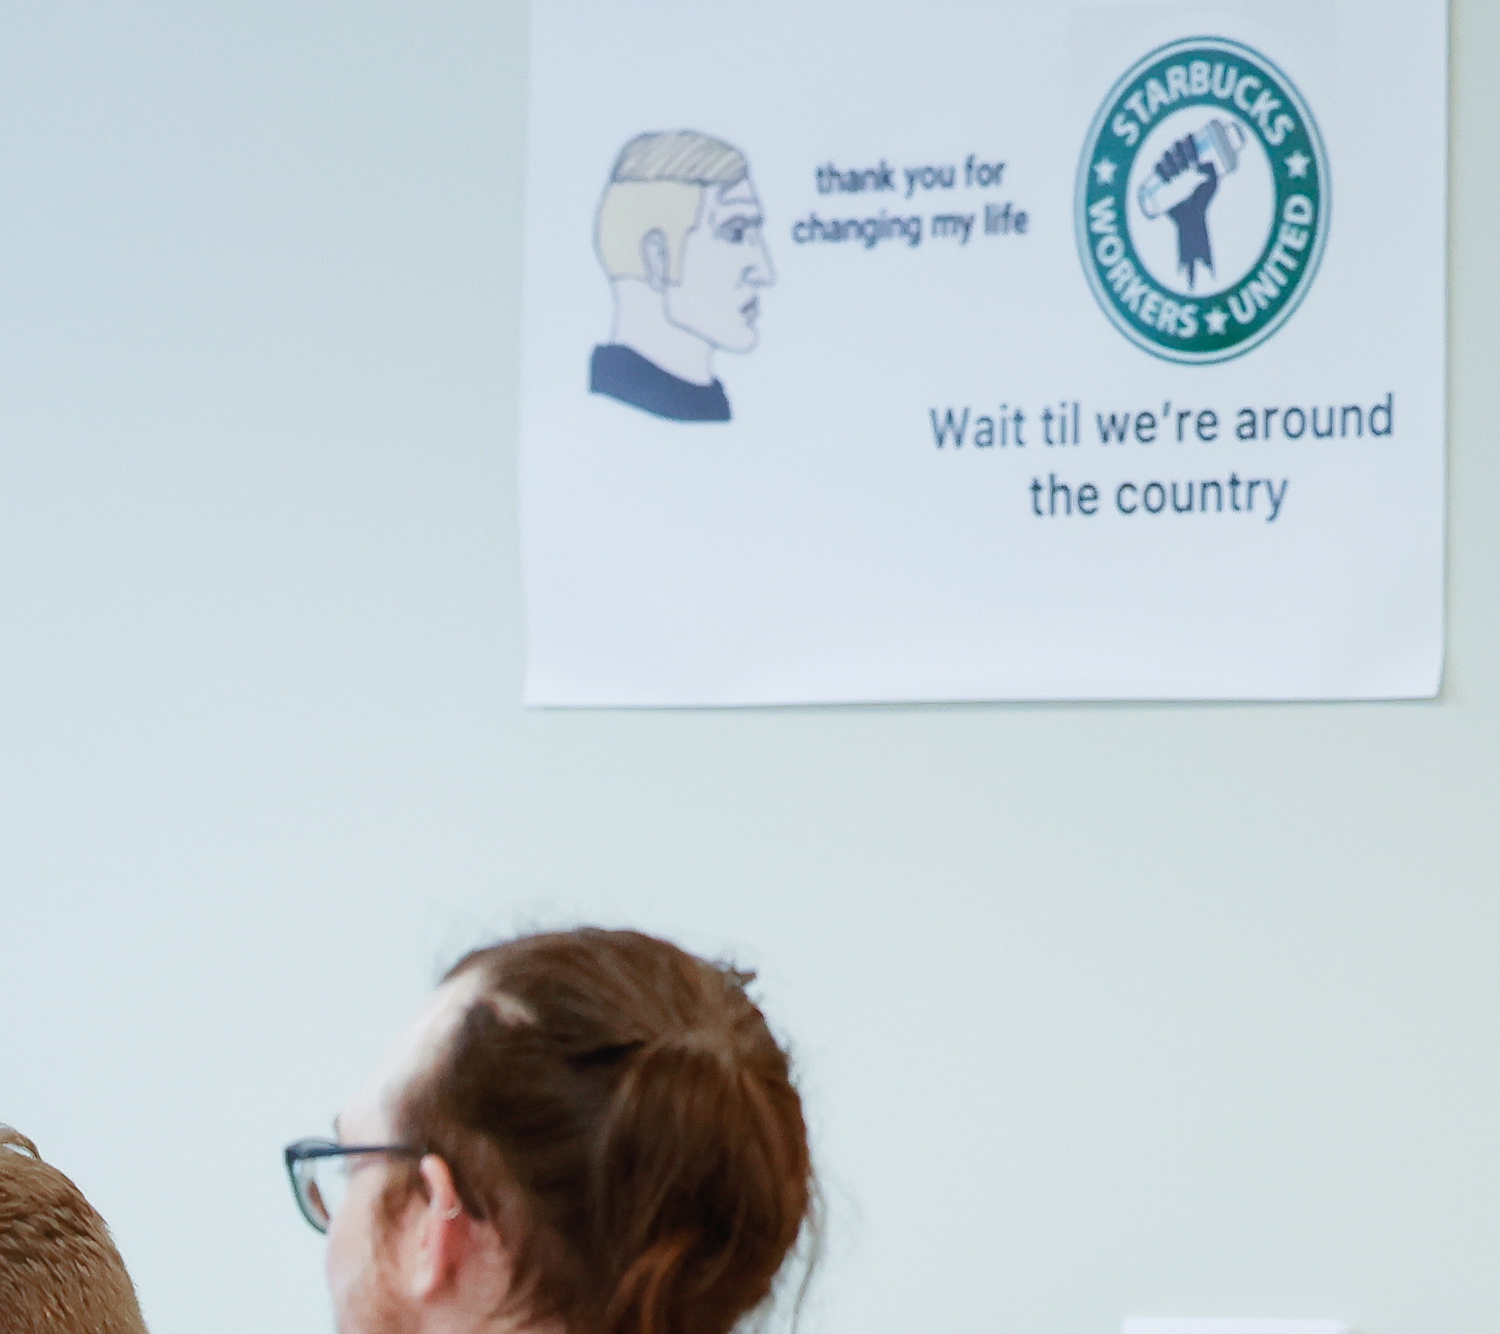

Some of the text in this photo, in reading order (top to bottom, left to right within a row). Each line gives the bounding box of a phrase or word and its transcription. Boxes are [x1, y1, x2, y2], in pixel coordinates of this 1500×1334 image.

[1112, 60, 1295, 146] STARBUCKS
[815, 155, 1006, 198] thank you for
[790, 204, 1029, 249] changing my life
[1089, 194, 1315, 339] WORKERS UNITED
[930, 407, 1025, 450] Wait
[1043, 403, 1081, 448] til
[1234, 394, 1395, 441] around
[1029, 470, 1290, 523] the country
